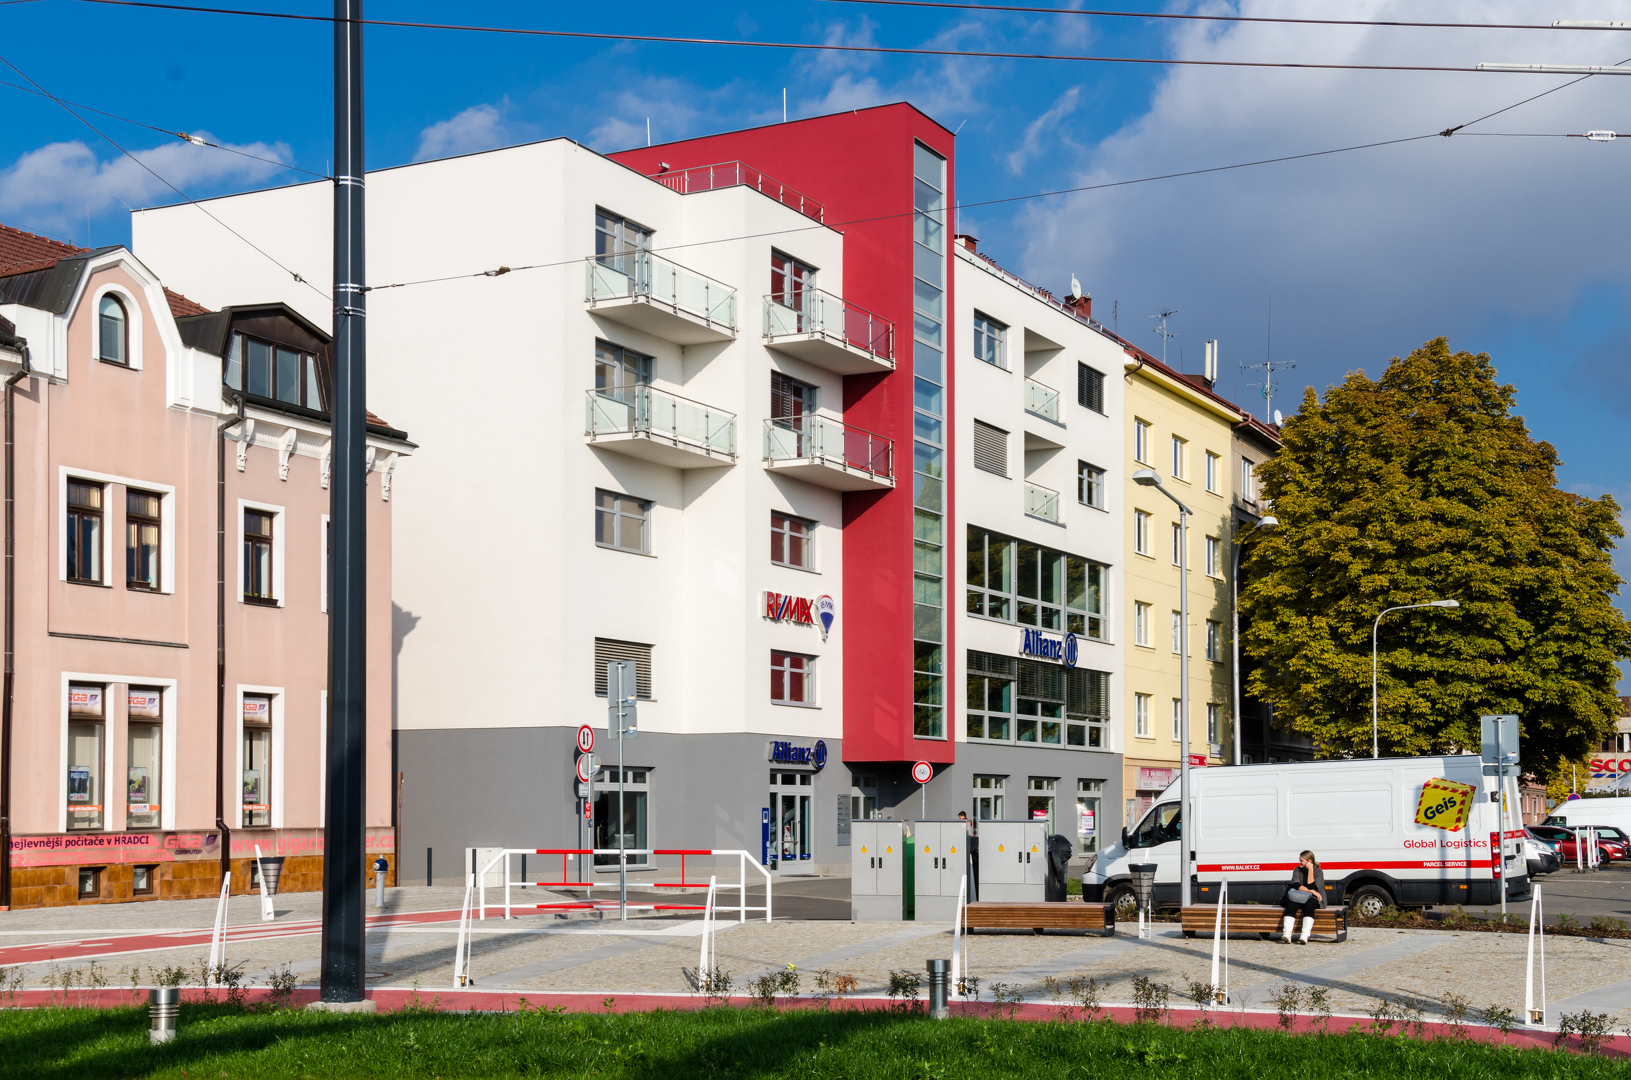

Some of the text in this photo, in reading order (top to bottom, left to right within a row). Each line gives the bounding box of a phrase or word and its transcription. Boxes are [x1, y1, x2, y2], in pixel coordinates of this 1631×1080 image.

[767, 591, 814, 624] RE/MAX
[1023, 628, 1062, 659] Allianz
[772, 741, 812, 762] Allianz
[1423, 796, 1457, 820] Geis
[9, 836, 149, 850] nejlevnější počítače v HRADCI
[1403, 838, 1487, 849] Global Logistics
[22, 854, 49, 864] 70%
[52, 853, 80, 863] slevy,
[84, 852, 110, 861] 5000
[112, 851, 122, 860] ks
[125, 850, 165, 860] skladem
